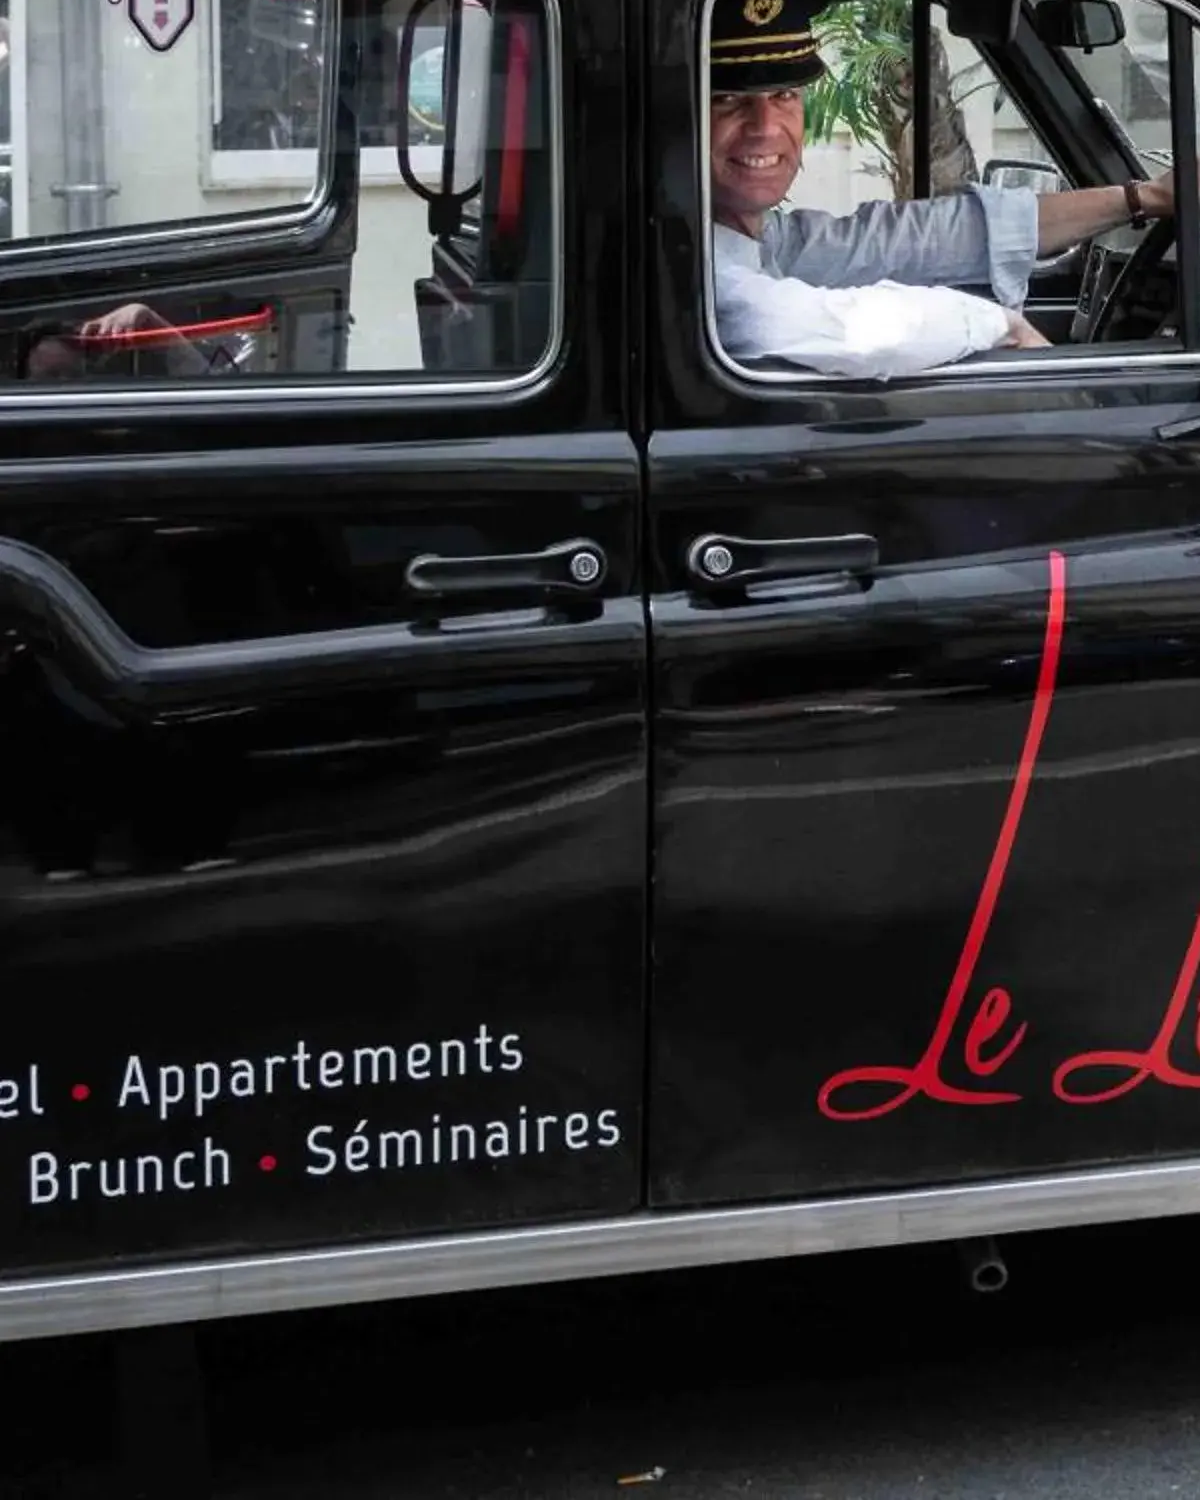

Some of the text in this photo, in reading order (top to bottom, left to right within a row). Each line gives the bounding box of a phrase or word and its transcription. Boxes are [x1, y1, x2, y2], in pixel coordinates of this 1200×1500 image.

[816, 552, 1067, 1121] Le
[118, 1024, 524, 1120] Appartements
[30, 1105, 620, 1204] Brunch Séminaires
